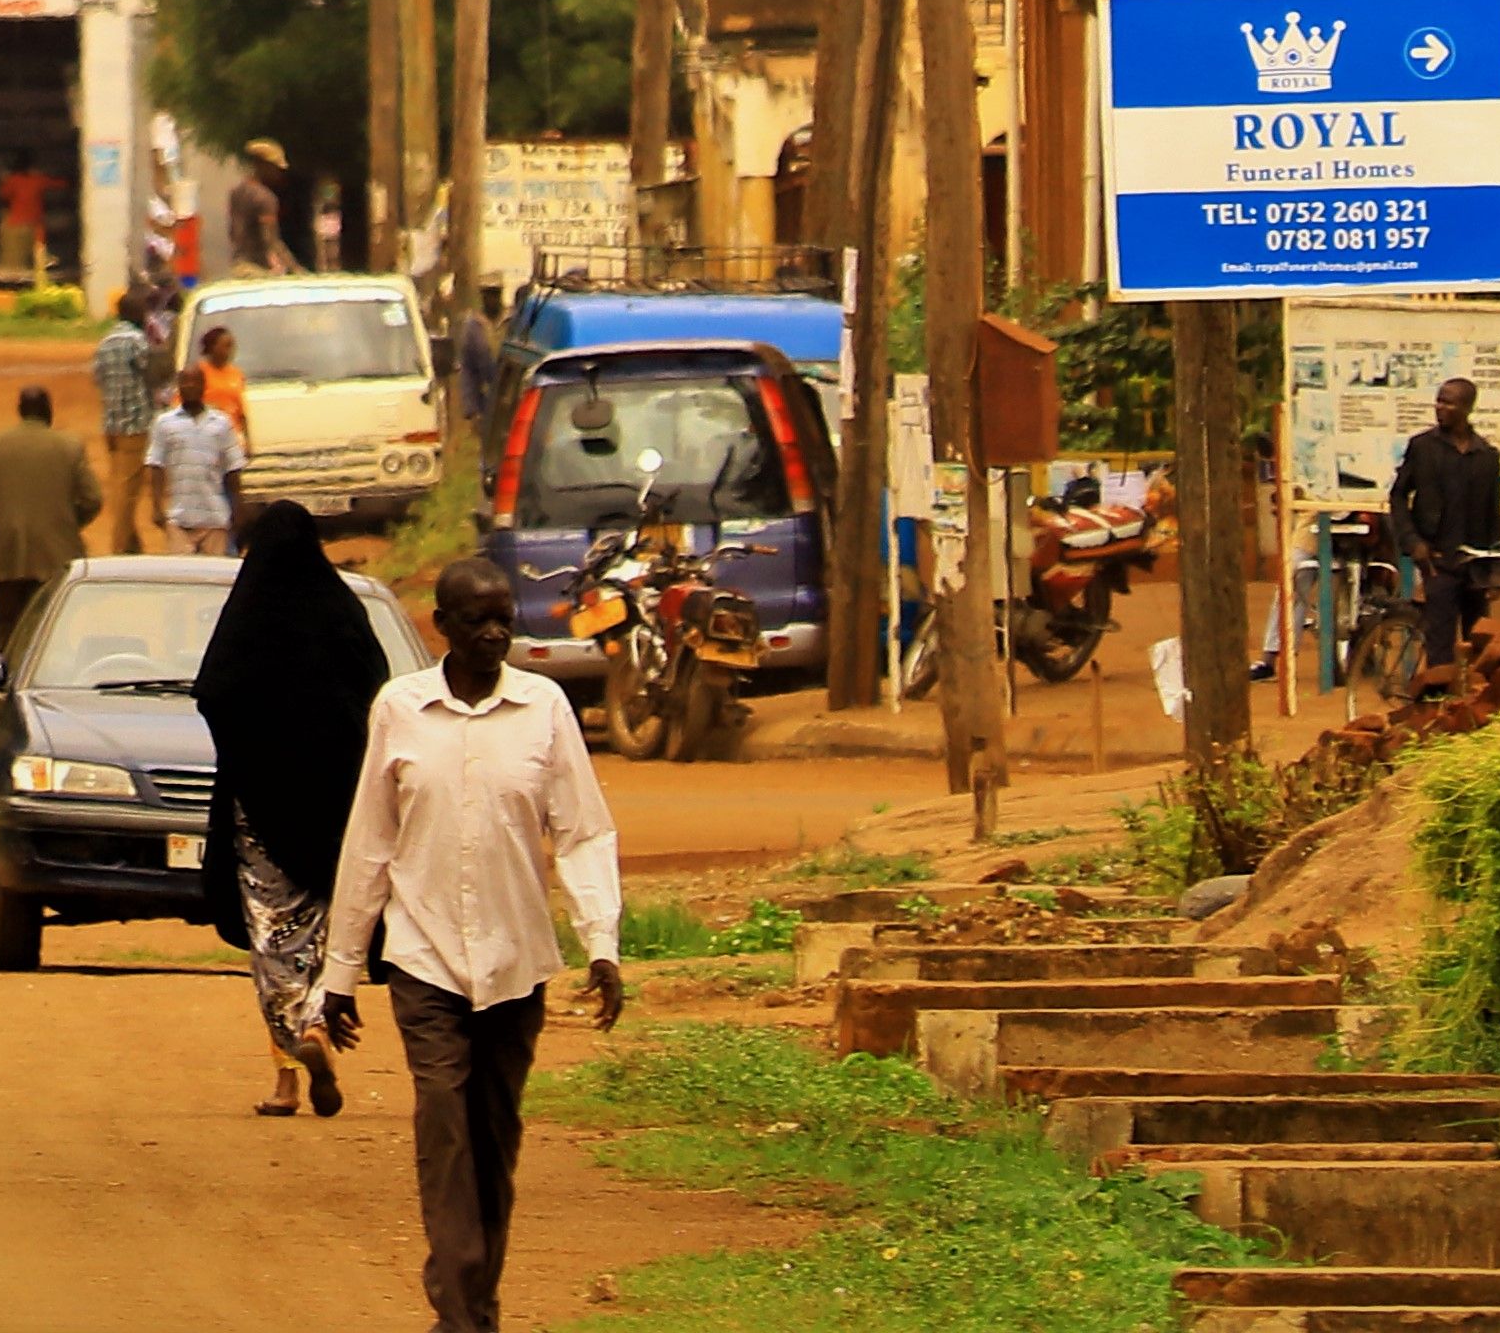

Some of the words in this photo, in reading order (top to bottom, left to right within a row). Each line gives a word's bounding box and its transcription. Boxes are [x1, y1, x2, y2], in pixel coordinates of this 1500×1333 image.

[1271, 77, 1319, 88] ROYAL
[1233, 111, 1406, 150] ROYAL
[1226, 161, 1322, 182] Funeral
[1333, 160, 1415, 180] Homes
[1202, 203, 1257, 225] TEL:
[1266, 202, 1326, 224] 0752
[1332, 200, 1379, 223] 260
[1384, 199, 1428, 221] 321
[1266, 228, 1327, 251] 0782
[1332, 228, 1377, 250] 081
[1384, 227, 1431, 249] 957
[1221, 262, 1254, 273] Email:
